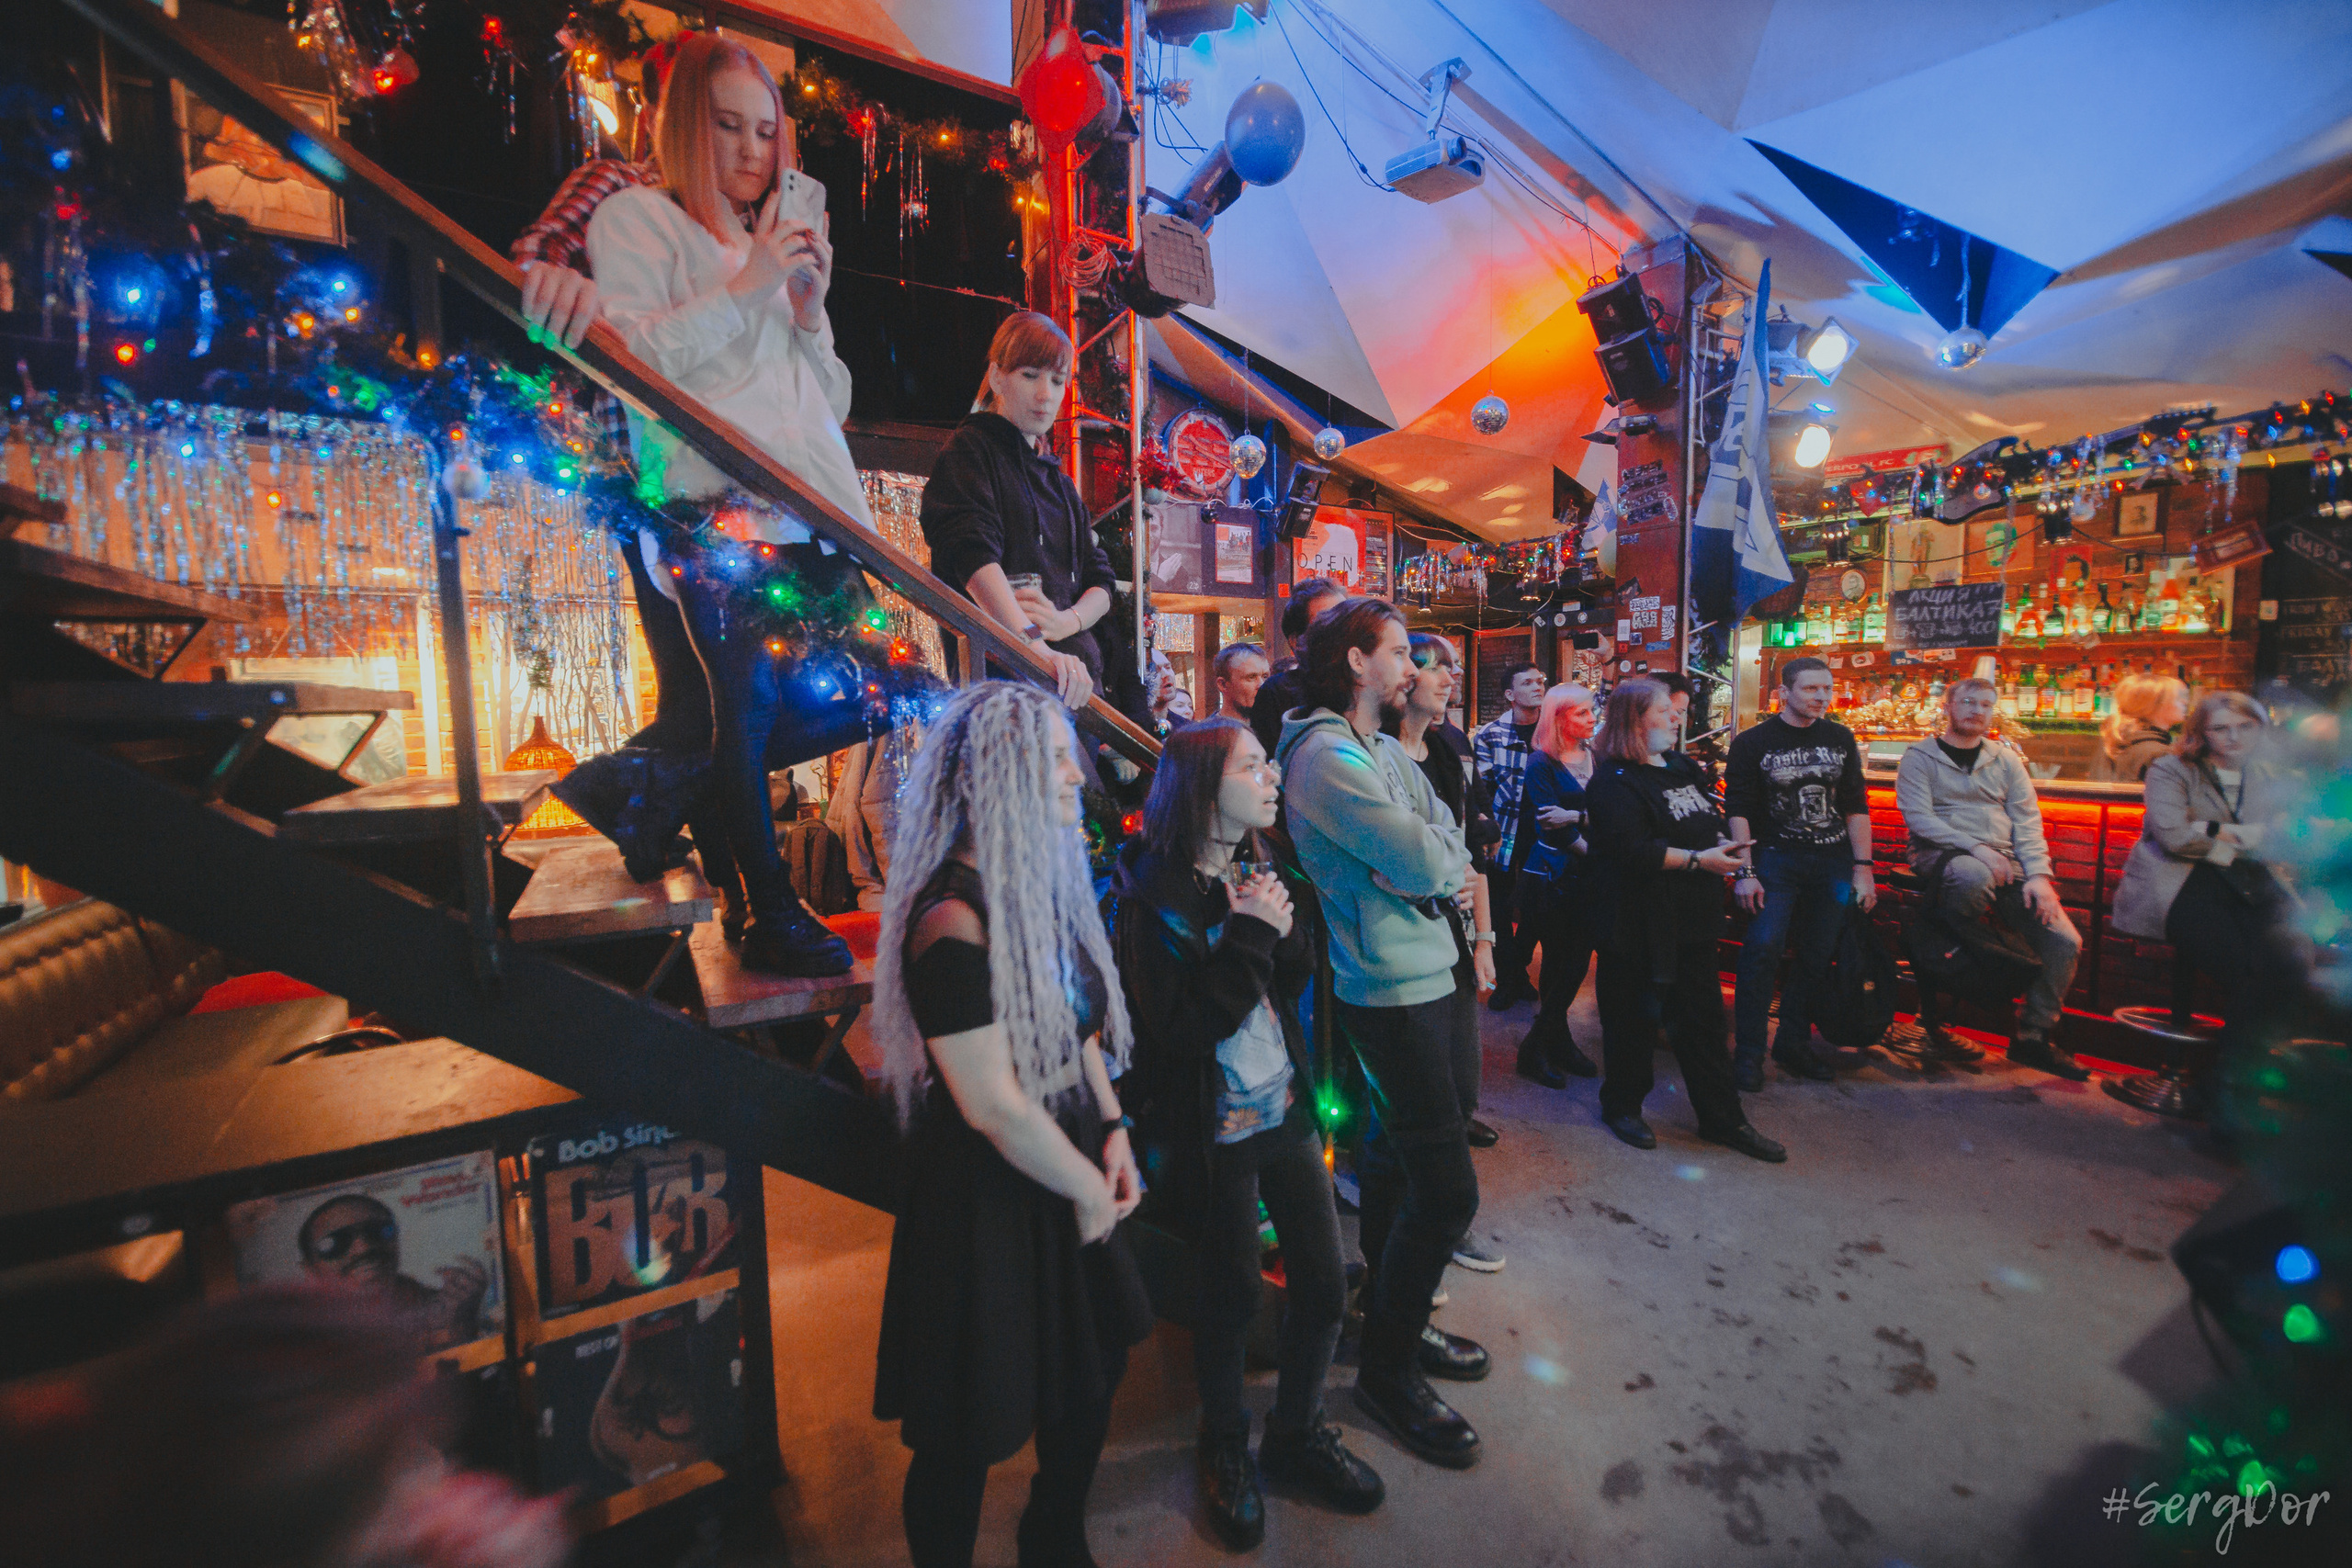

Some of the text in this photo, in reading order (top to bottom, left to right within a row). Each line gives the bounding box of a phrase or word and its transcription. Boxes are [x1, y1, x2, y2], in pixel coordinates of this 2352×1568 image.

[1826, 458, 1895, 472] ERPOL FC
[1296, 553, 1352, 571] OPEN
[1895, 602, 1984, 621] БАЛТИКА
[1759, 748, 1810, 771] Castle
[558, 1130, 619, 1163] Bob
